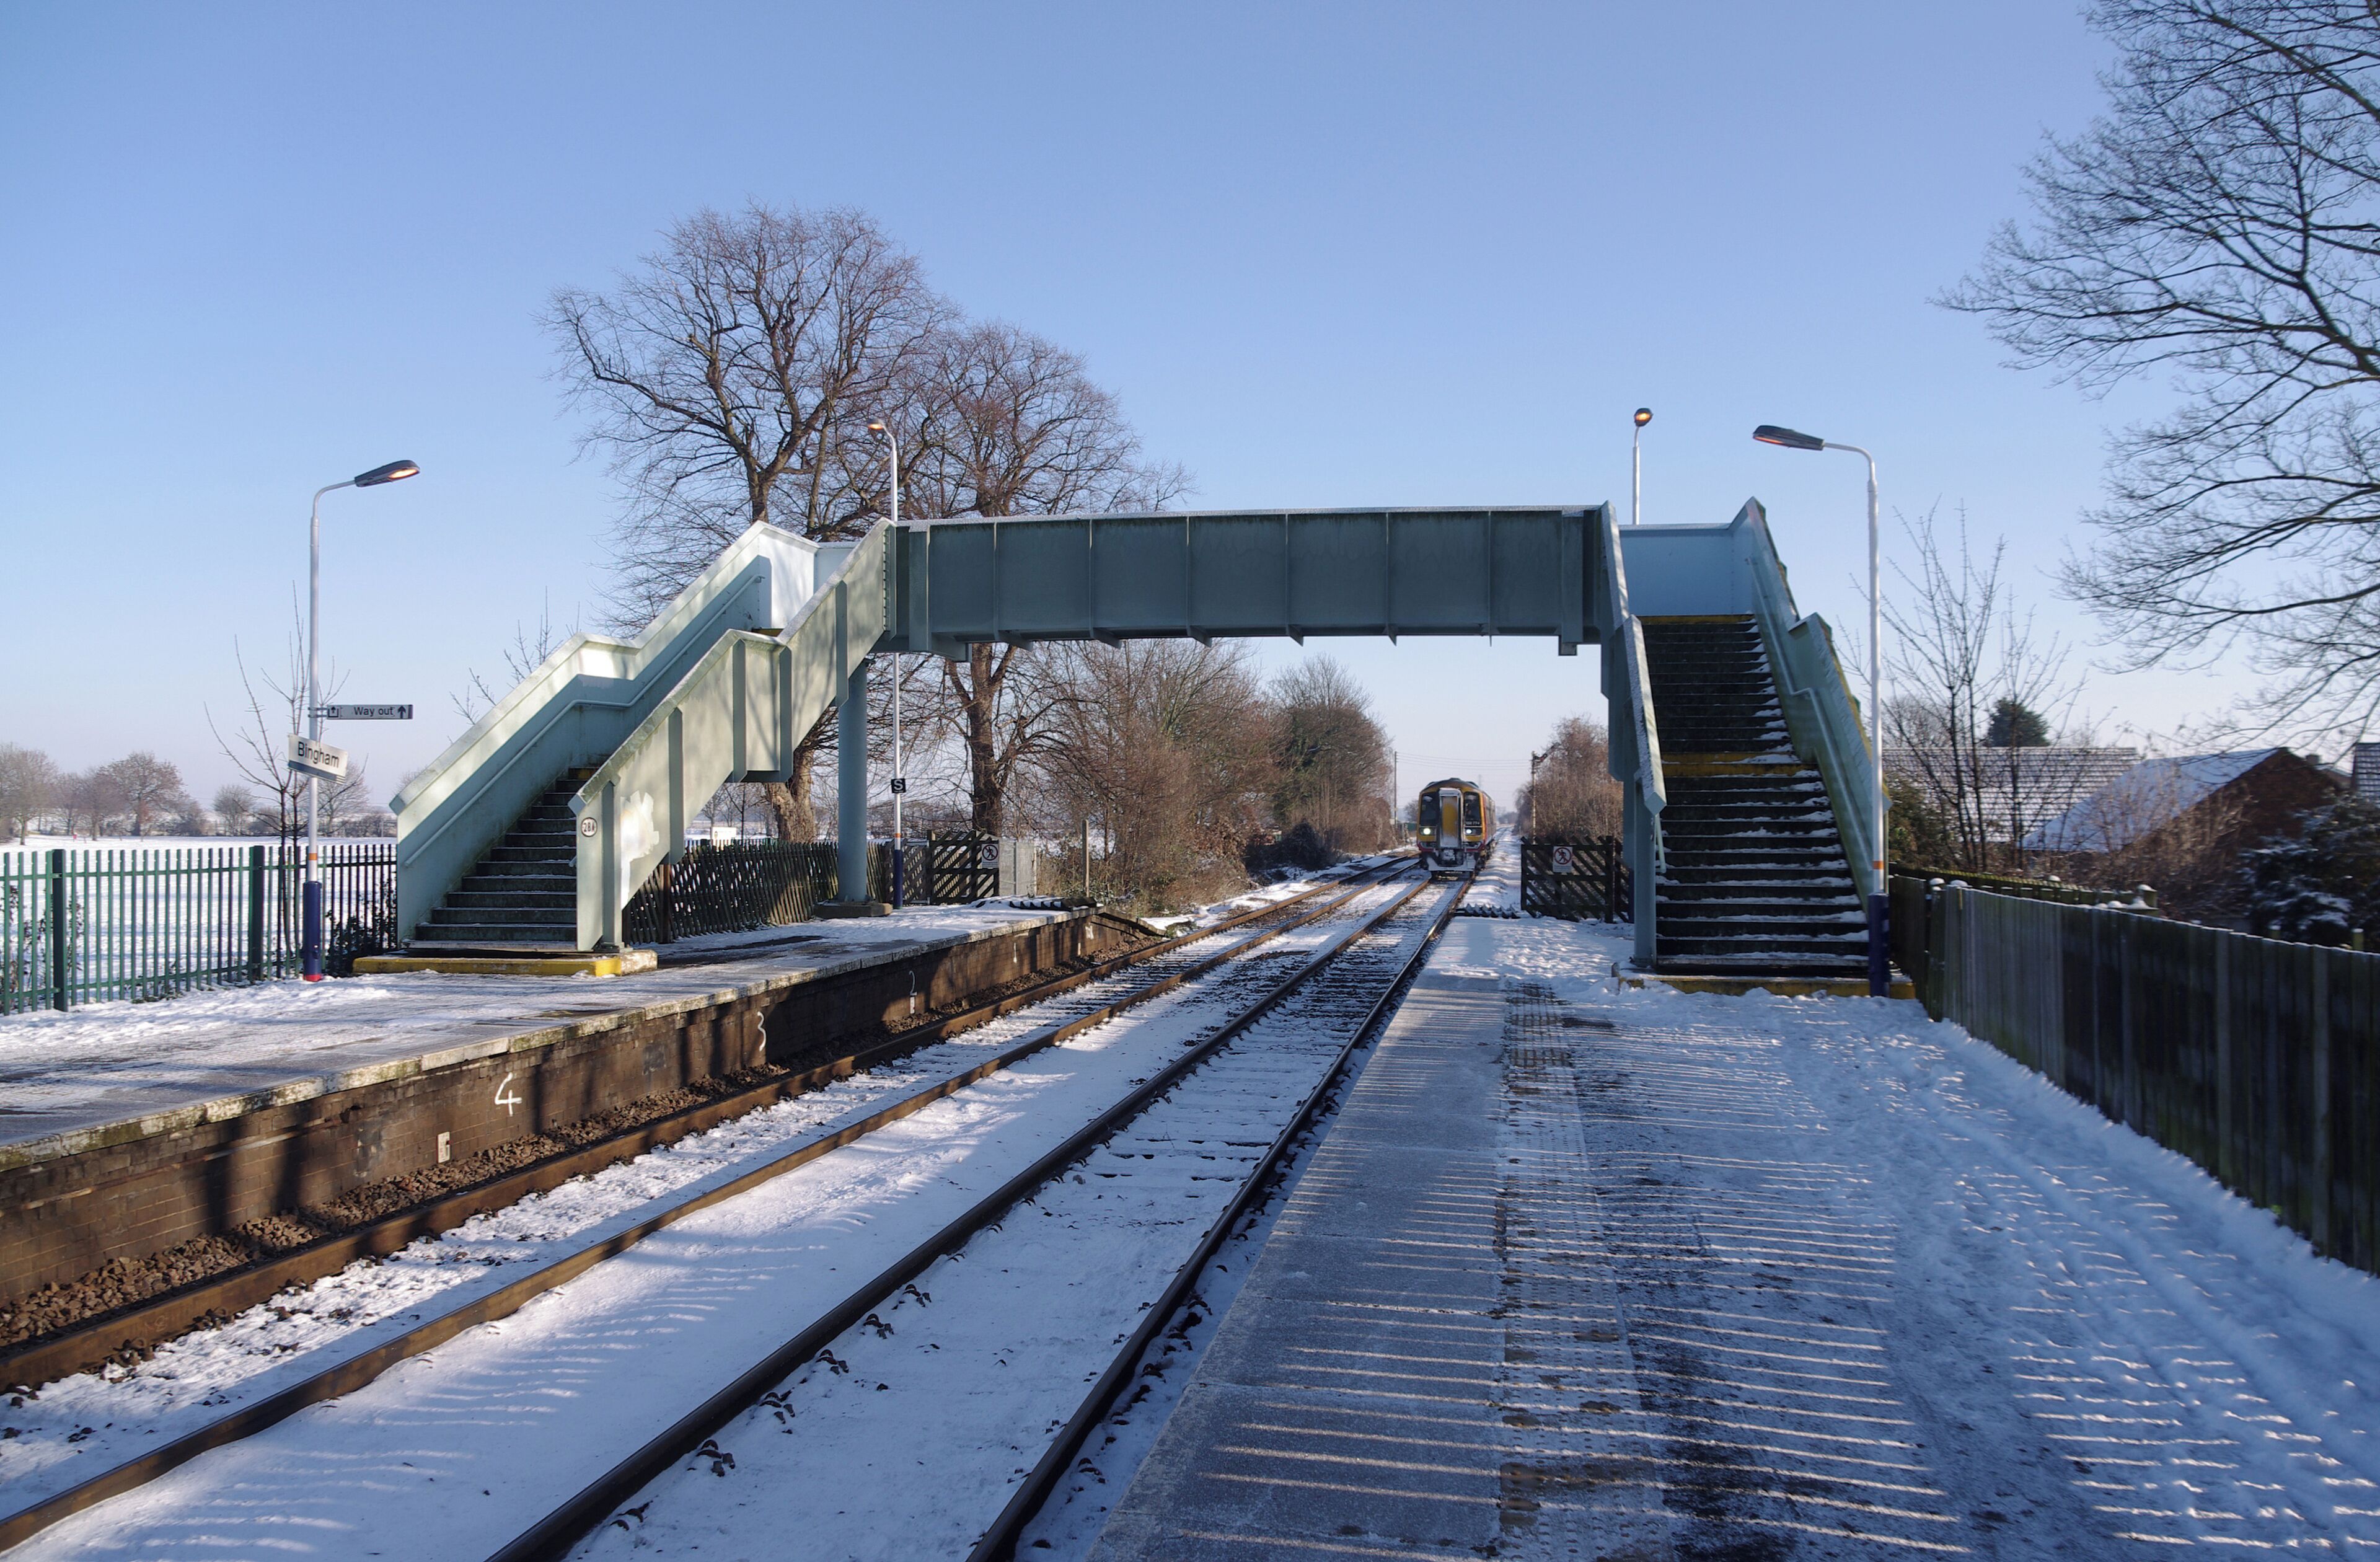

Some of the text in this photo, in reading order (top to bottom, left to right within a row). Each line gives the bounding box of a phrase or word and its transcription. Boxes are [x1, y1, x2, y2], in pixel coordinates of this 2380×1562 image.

[354, 707, 394, 717] Way out
[298, 741, 339, 768] Bingham
[894, 779, 904, 790] S
[909, 971, 917, 995] 2
[757, 1011, 767, 1052] 3
[495, 1072, 522, 1116] 4
